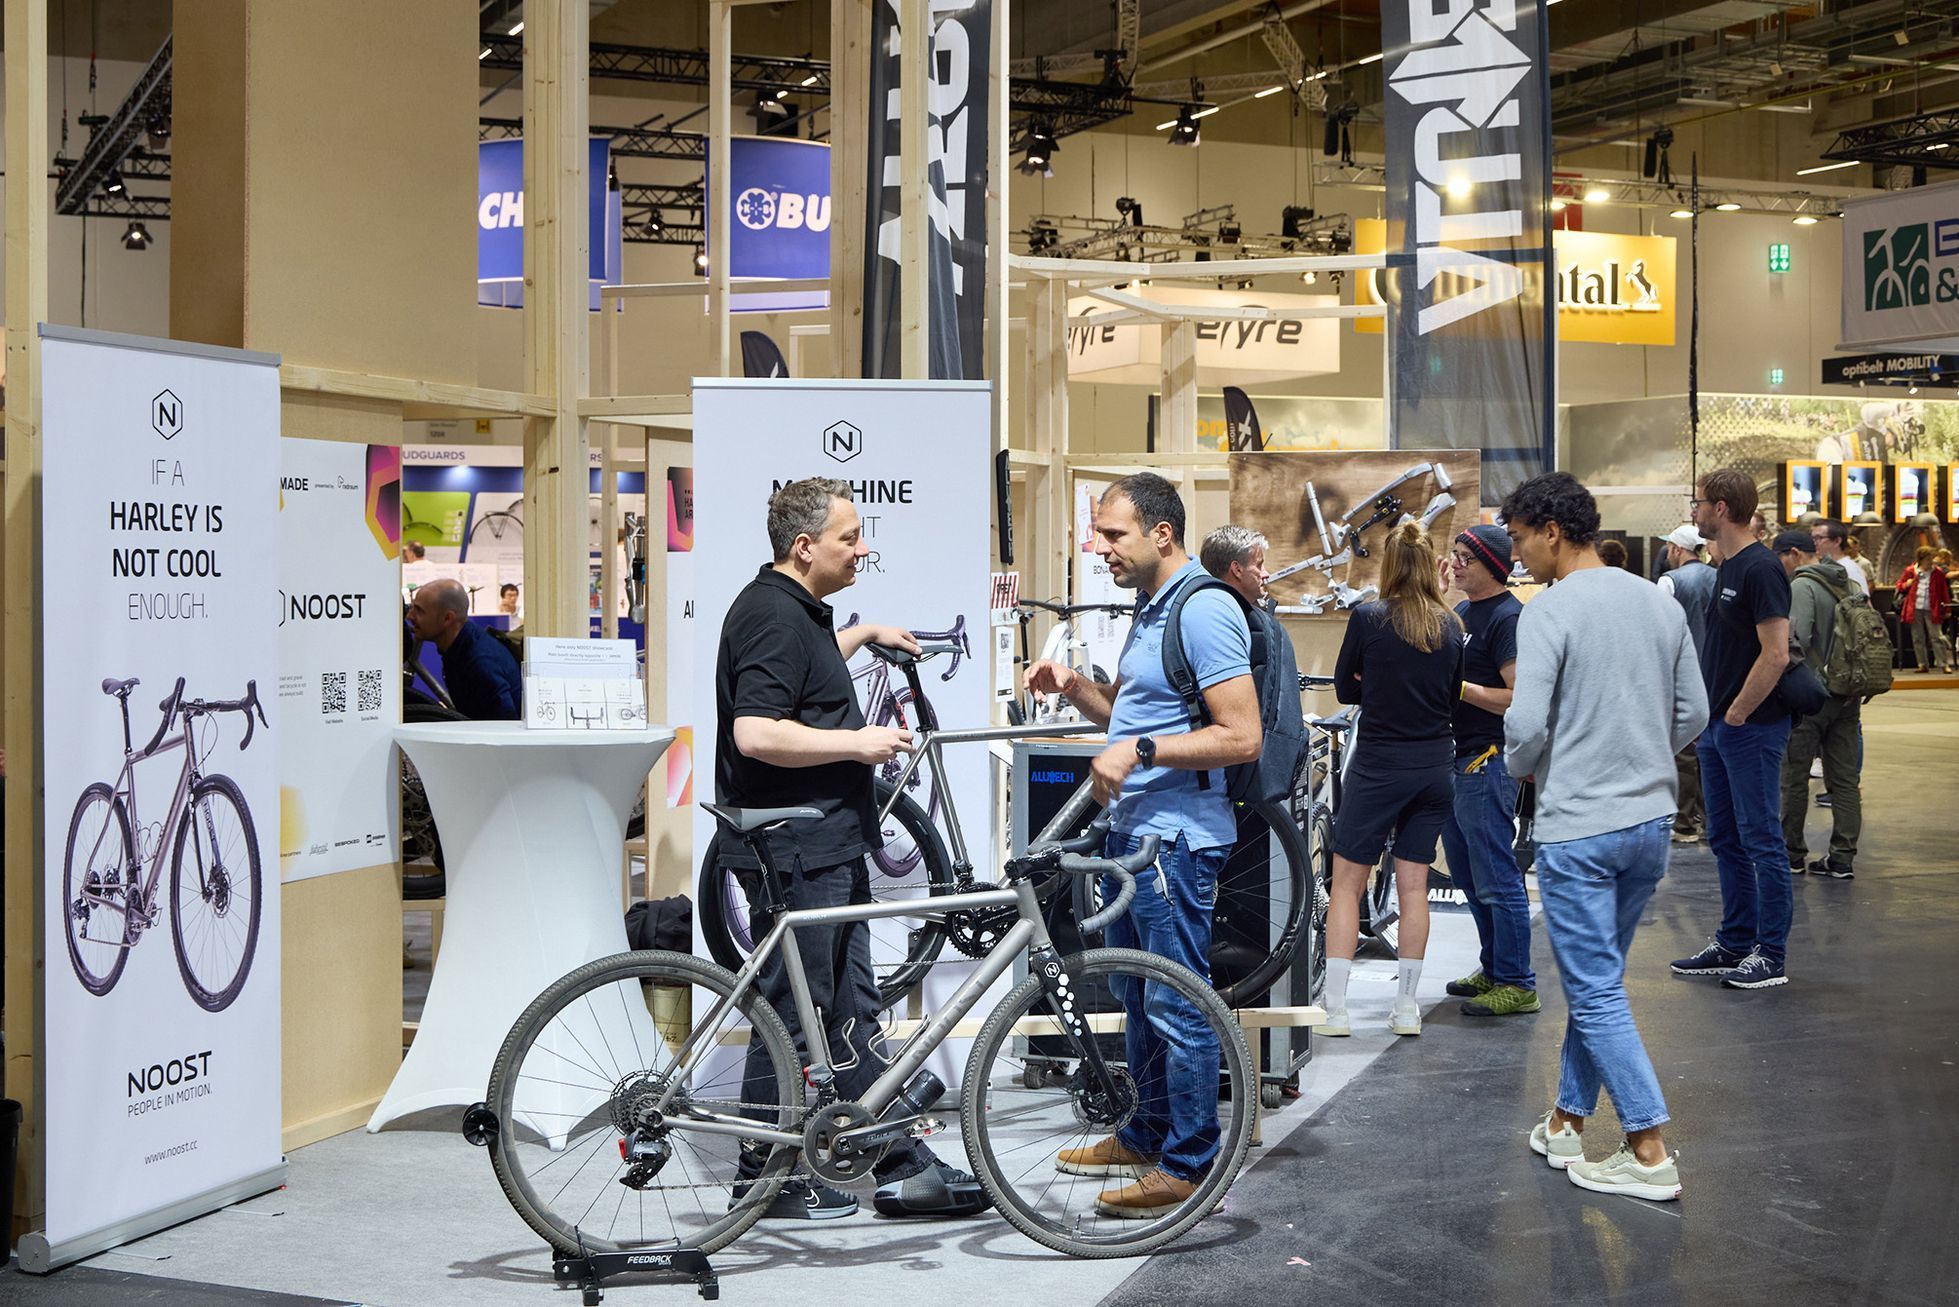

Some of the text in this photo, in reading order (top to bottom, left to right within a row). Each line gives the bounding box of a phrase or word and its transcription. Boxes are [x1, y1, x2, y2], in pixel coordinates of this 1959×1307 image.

[1842, 355, 1940, 379] optibelt MOBILITY
[151, 458, 185, 487] IF A
[110, 501, 223, 533] HARLEY IS
[112, 548, 221, 578] NOT COOL
[128, 592, 209, 620] ENOUGH.
[291, 594, 366, 620] NOOST
[128, 1050, 212, 1098] NOOST
[127, 1083, 213, 1118] PEOPLE IN MOTION.
[144, 1140, 198, 1165] www.noost.cc
[627, 1254, 673, 1265] FEEDBACK
